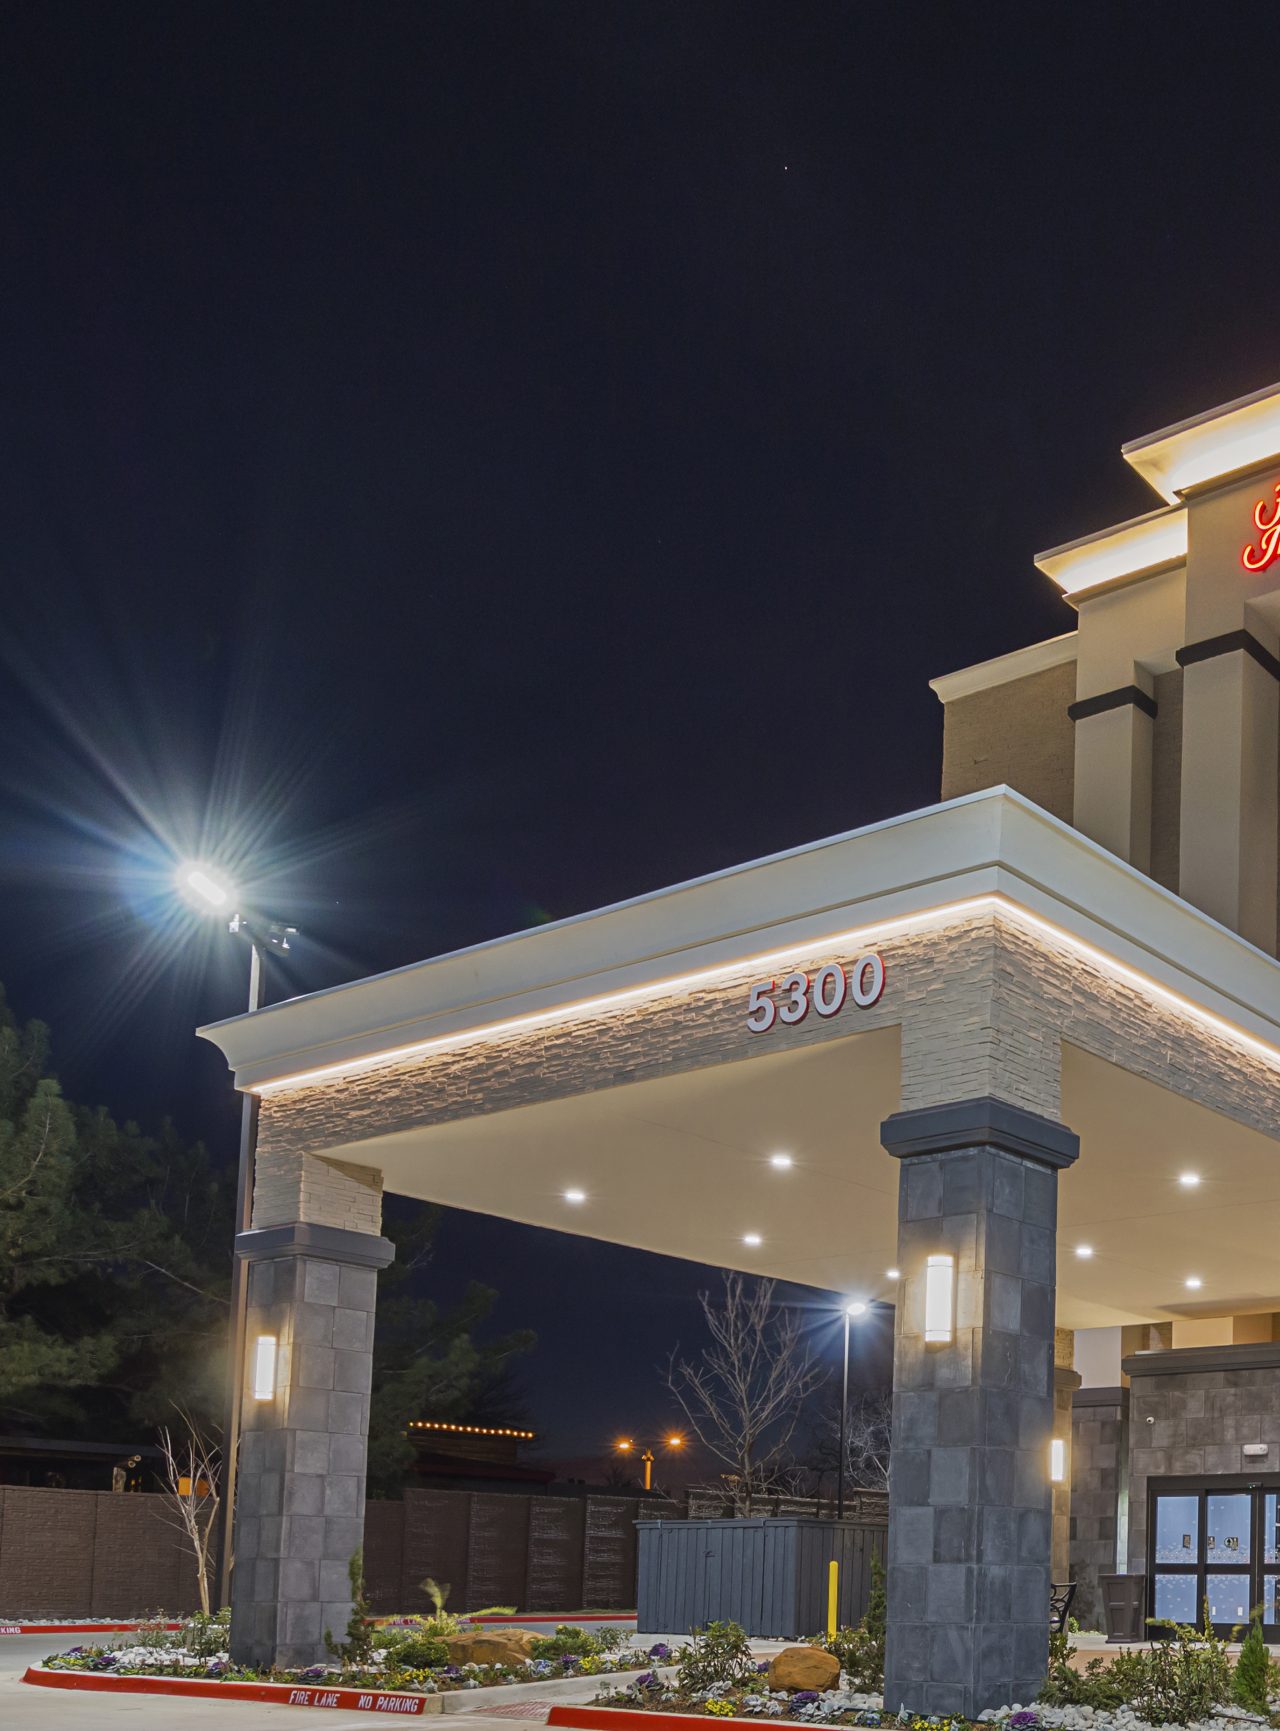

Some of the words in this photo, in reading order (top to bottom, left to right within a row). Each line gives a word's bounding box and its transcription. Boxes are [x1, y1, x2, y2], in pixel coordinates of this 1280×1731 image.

[746, 953, 886, 1034] 5300
[288, 1690, 311, 1705] FIRE
[313, 1692, 340, 1707] LANE
[358, 1694, 373, 1709] NO
[376, 1696, 420, 1713] PARKING
